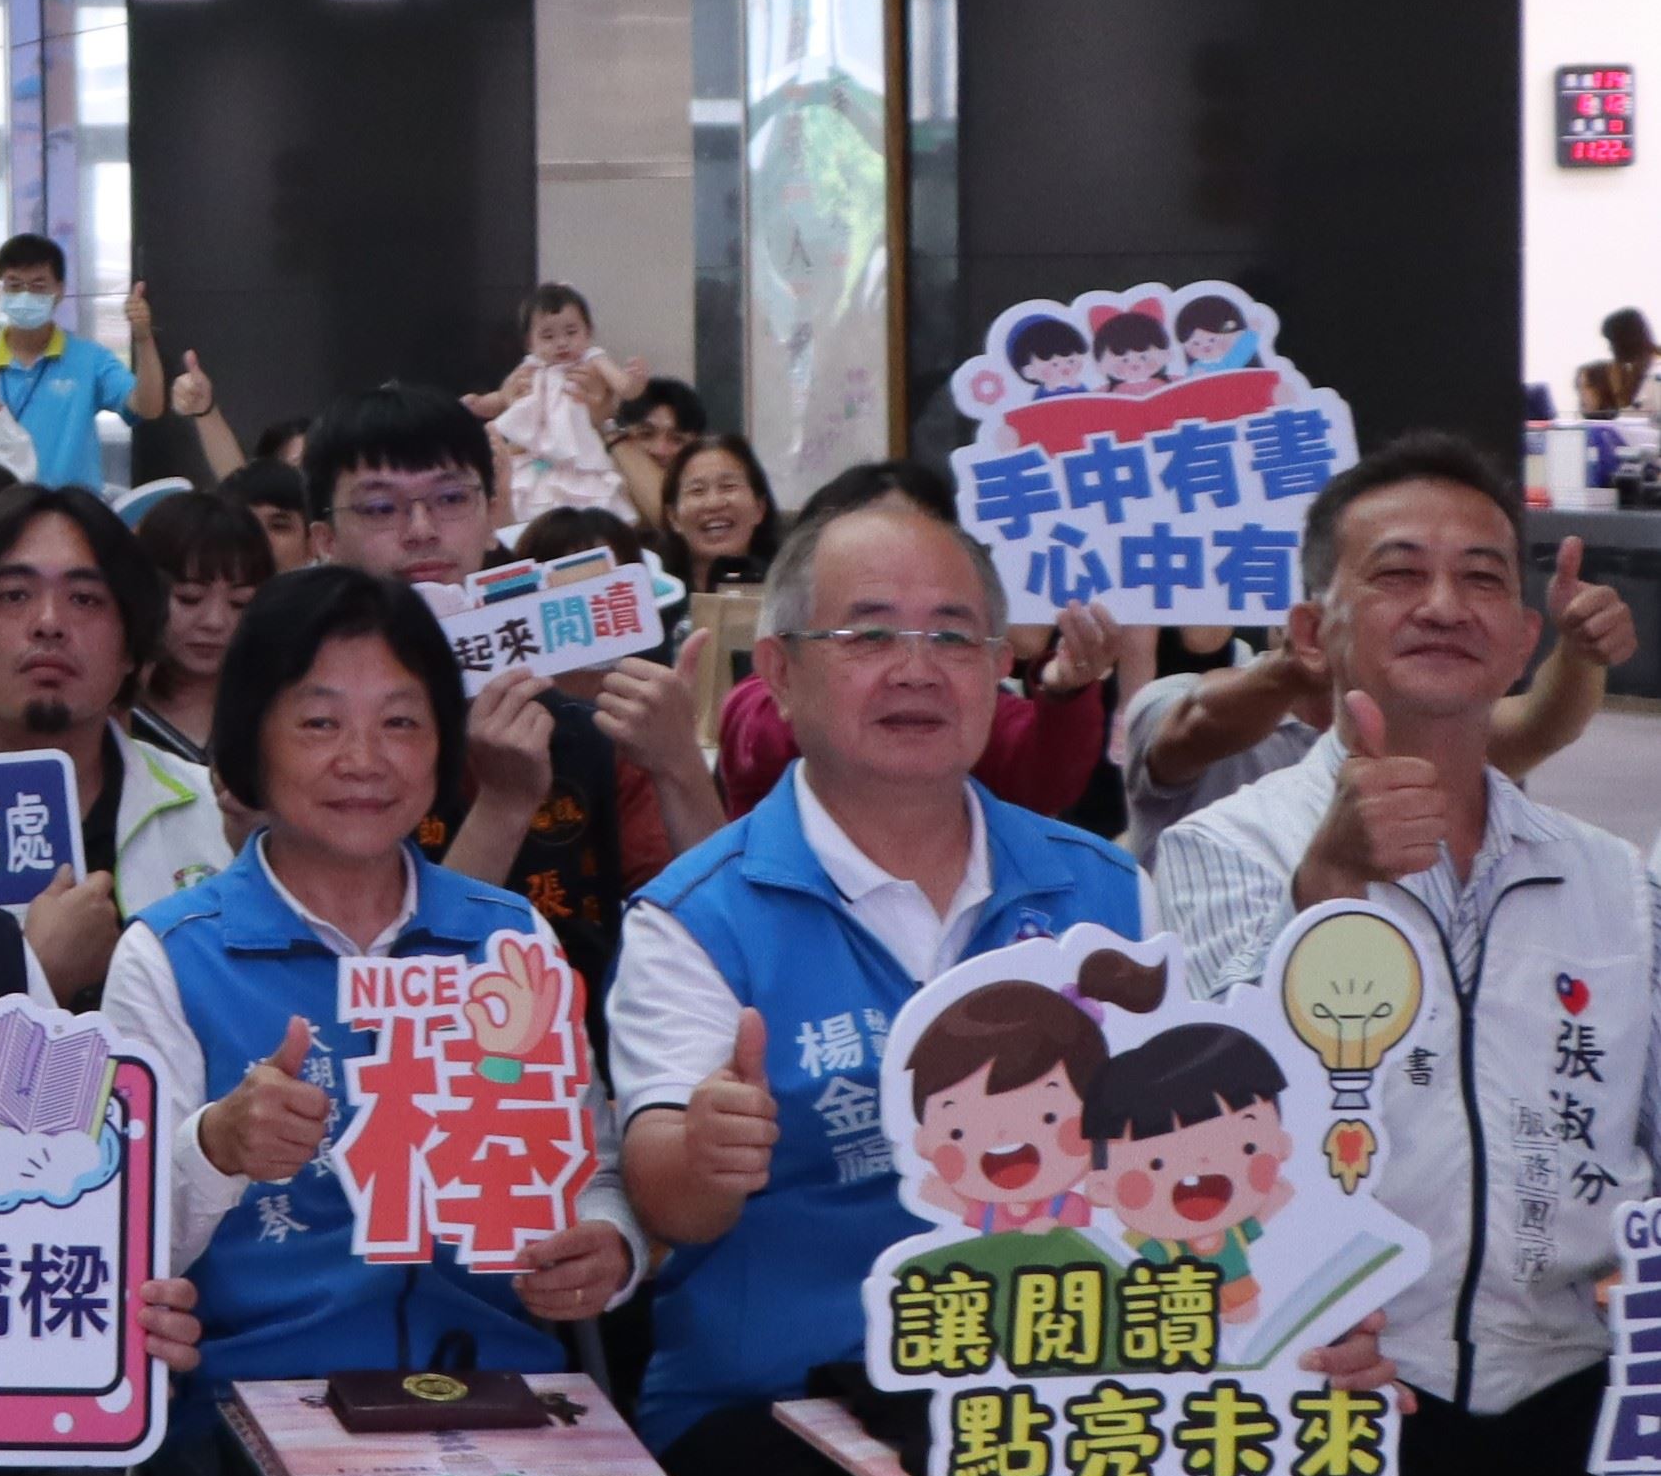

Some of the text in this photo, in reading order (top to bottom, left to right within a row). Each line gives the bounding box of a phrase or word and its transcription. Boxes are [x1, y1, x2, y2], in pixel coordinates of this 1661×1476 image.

[972, 408, 1338, 542] 手中有書
[349, 965, 461, 1010] NICE
[345, 1015, 576, 1254] 棒
[893, 1258, 1221, 1375] 讓閱讀
